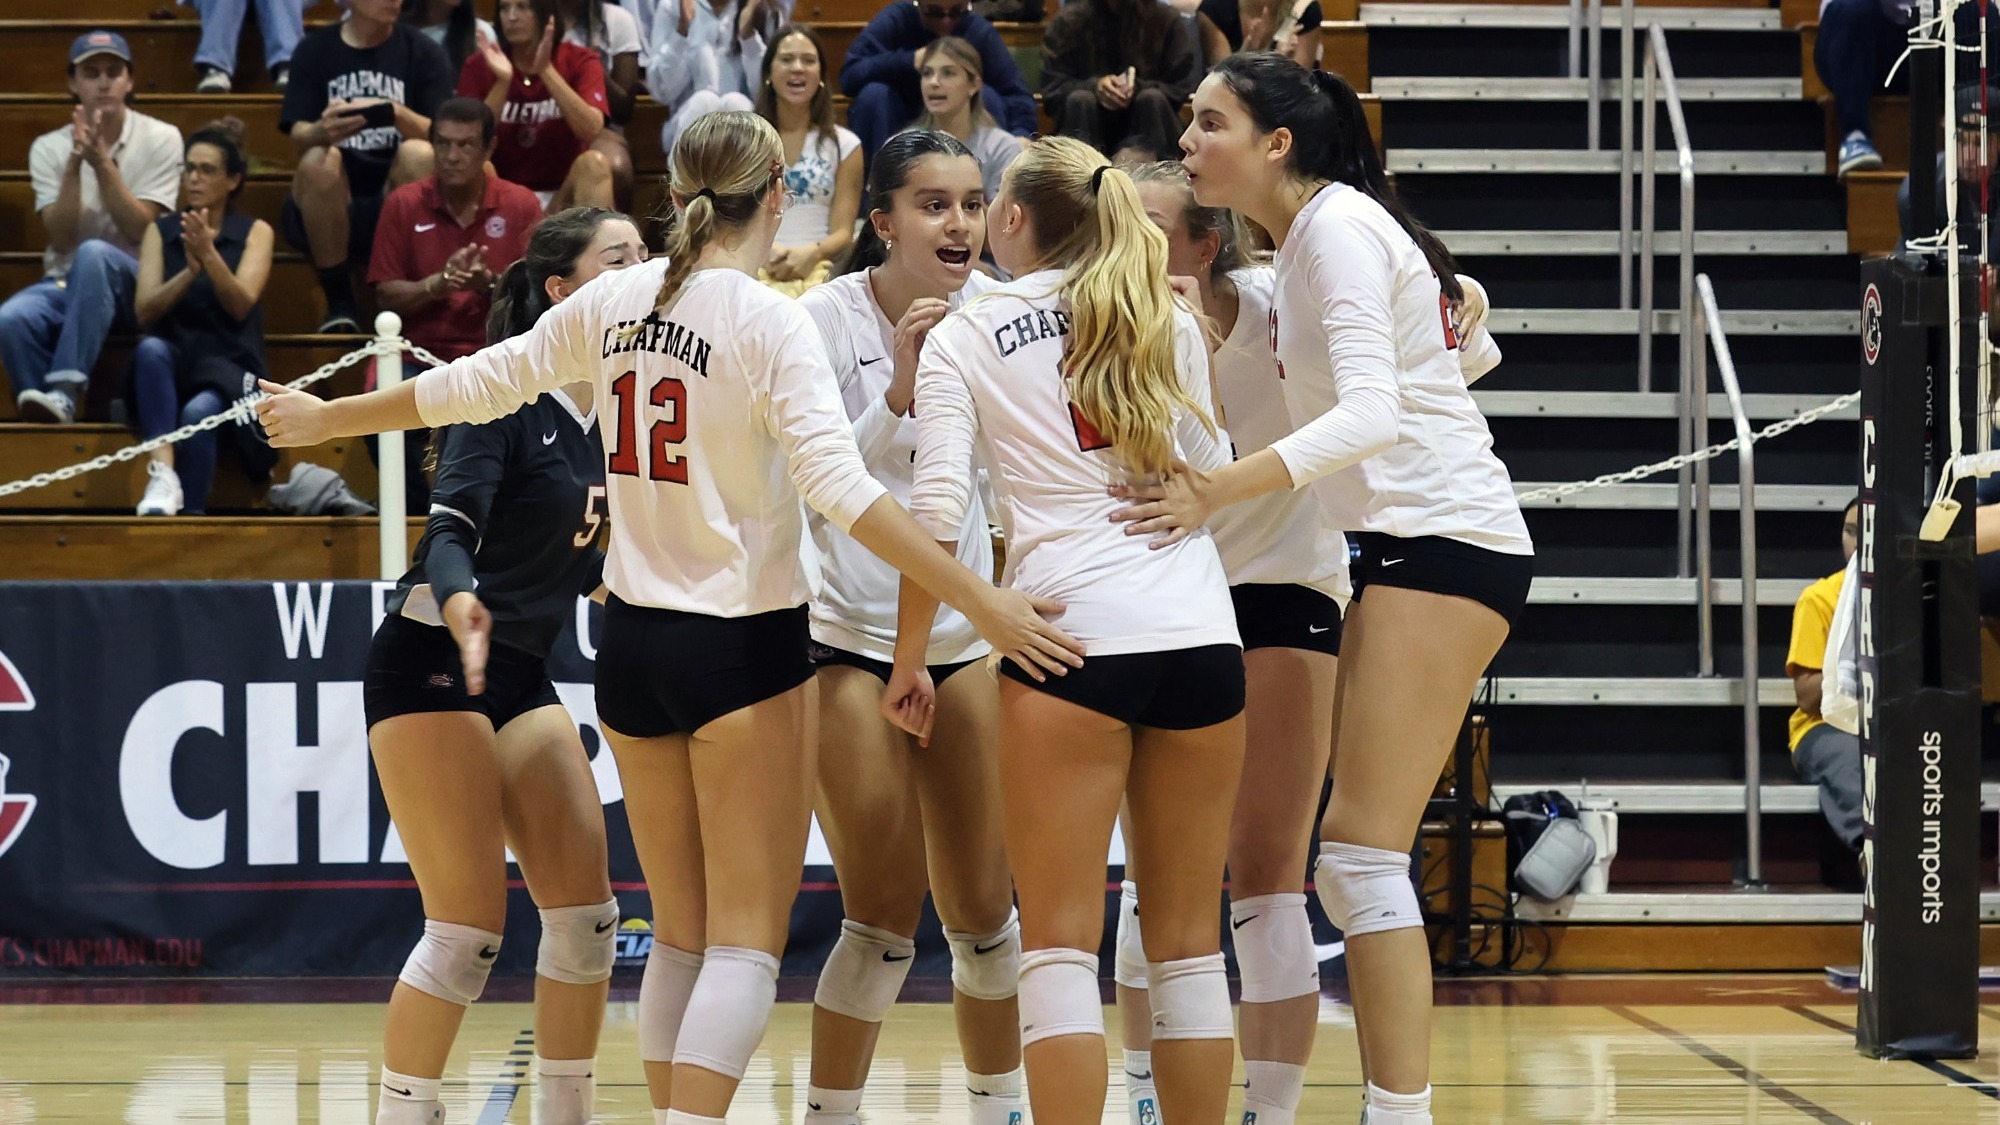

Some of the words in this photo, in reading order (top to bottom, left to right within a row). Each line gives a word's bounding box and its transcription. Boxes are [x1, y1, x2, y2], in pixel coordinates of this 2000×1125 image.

[327, 70, 405, 105] CHAPMAN
[602, 319, 711, 378] CHAPMAN
[994, 310, 1072, 358] CHAP
[608, 370, 689, 486] 12
[1918, 731, 1944, 816] sports
[1918, 820, 1944, 924] imports
